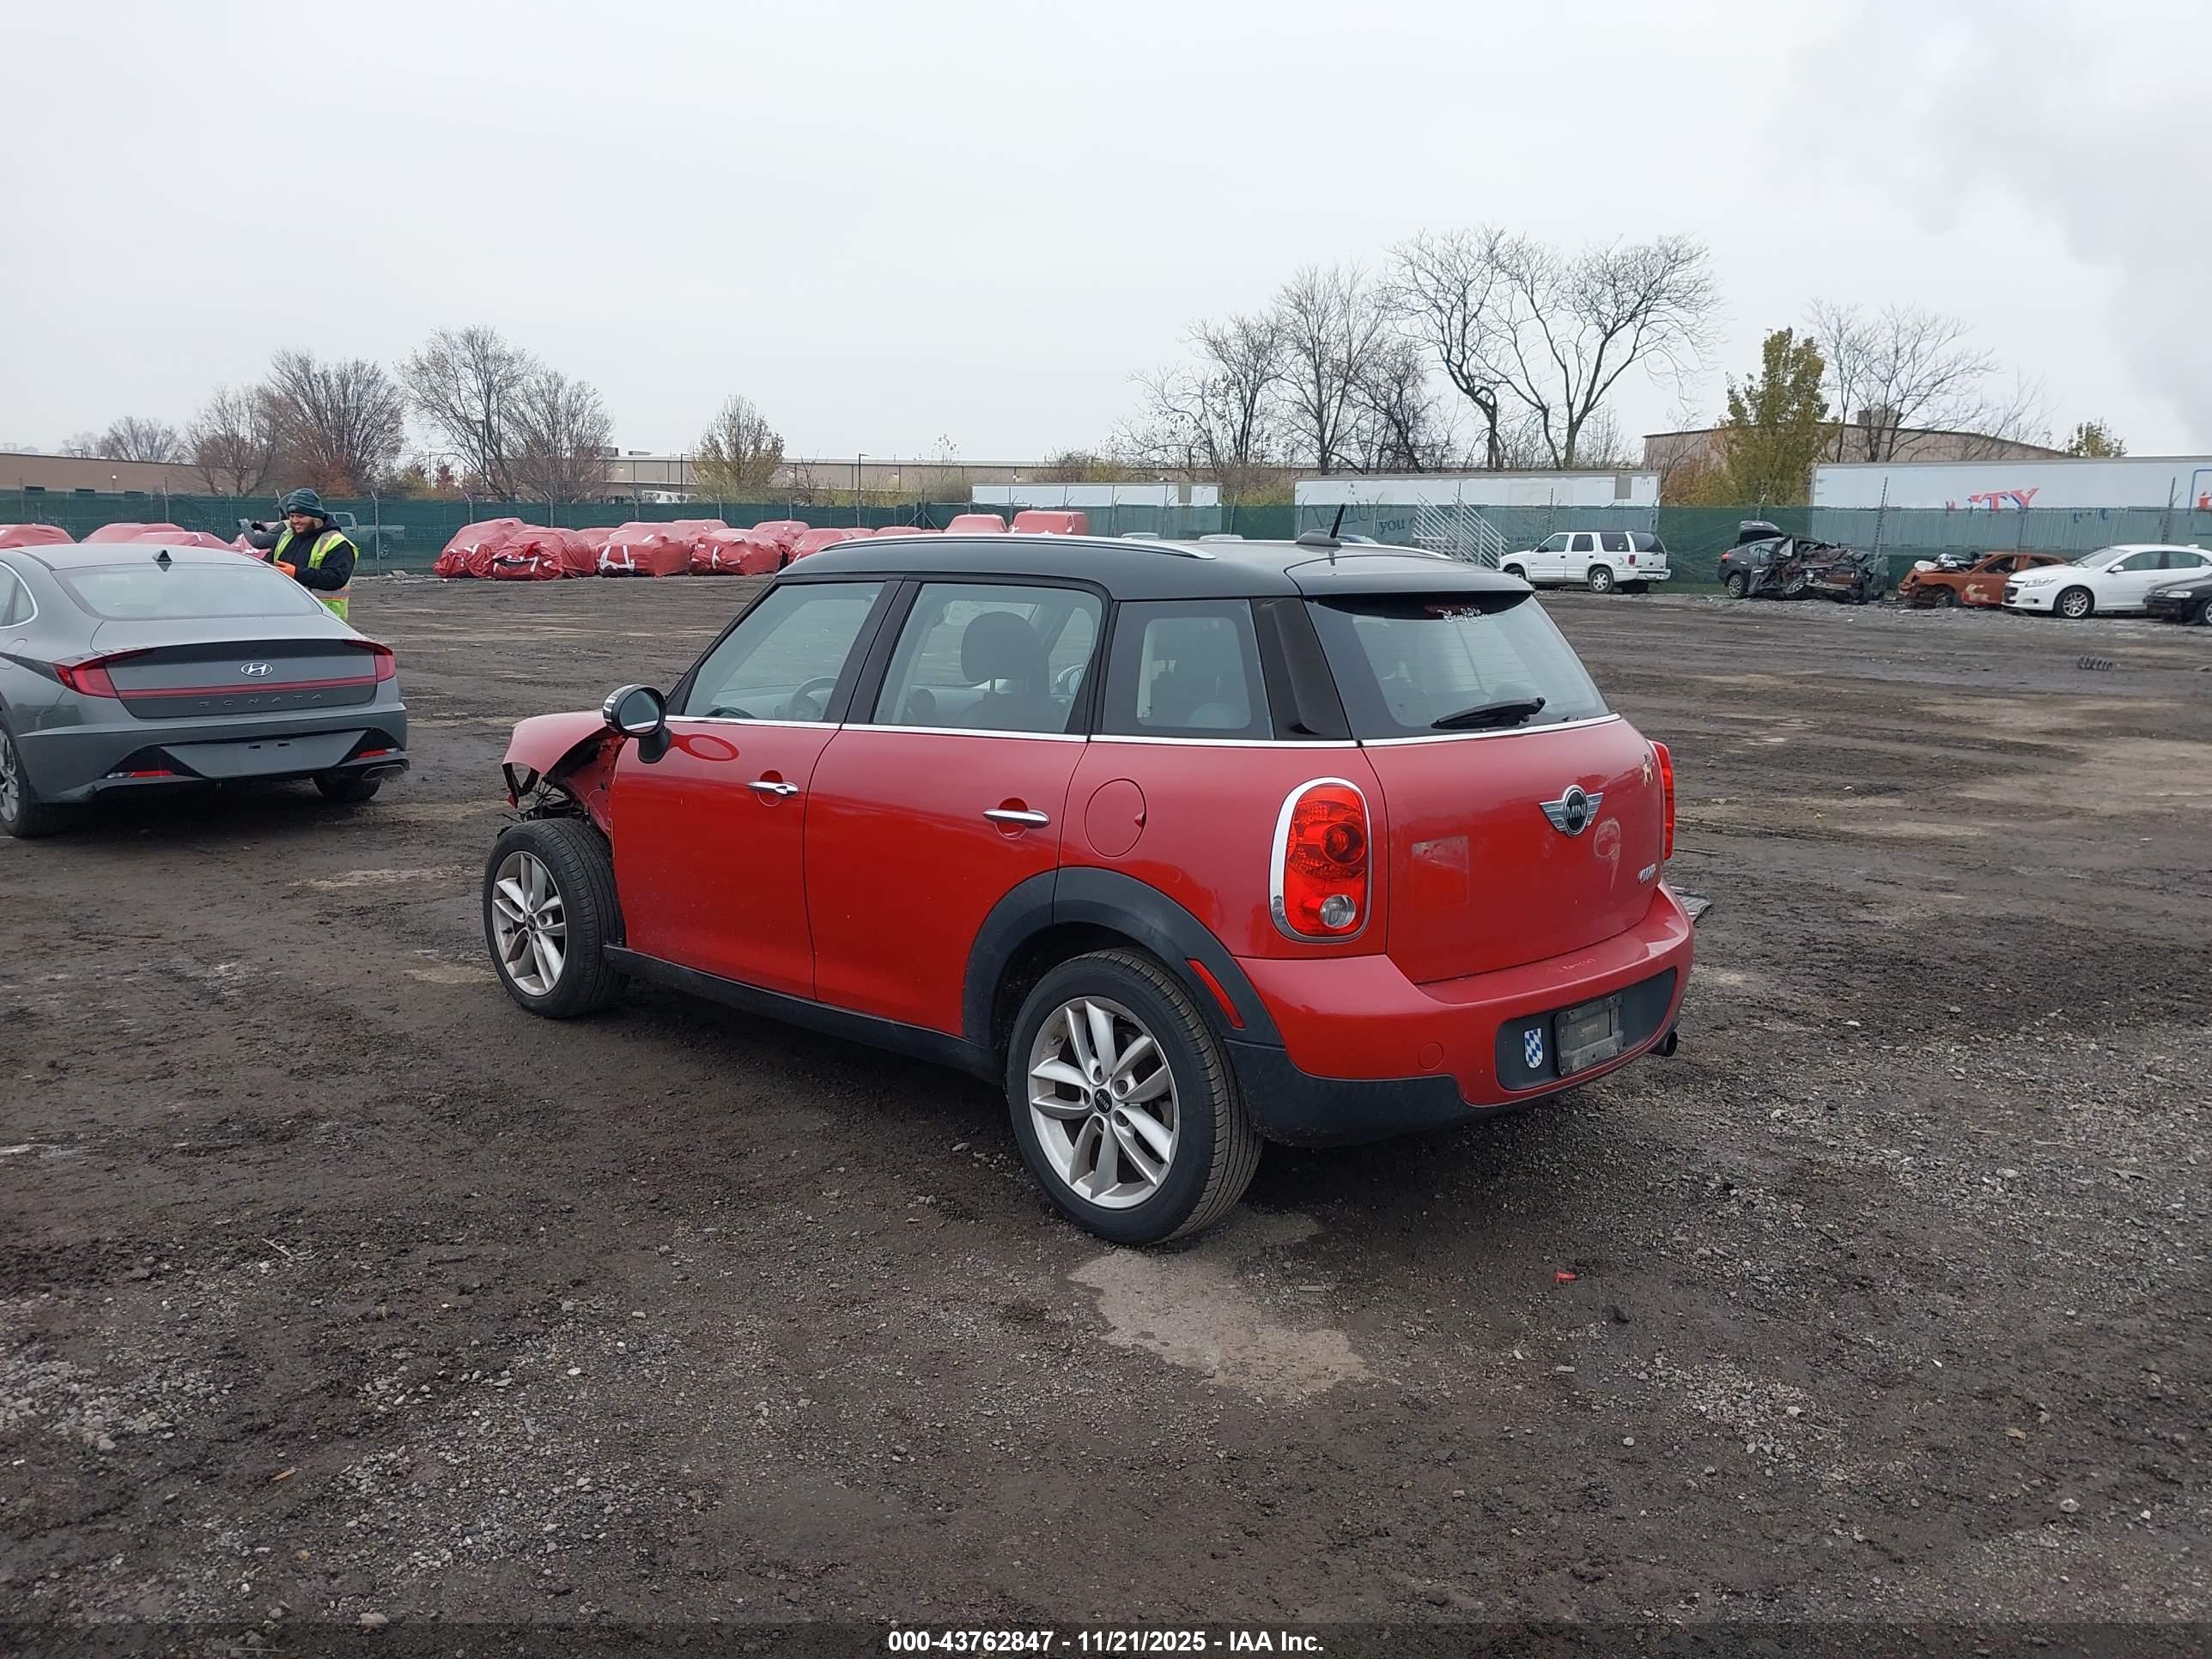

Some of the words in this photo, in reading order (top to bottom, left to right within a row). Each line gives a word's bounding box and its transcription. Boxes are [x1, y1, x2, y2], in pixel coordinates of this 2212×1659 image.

[1378, 518, 1407, 536] you
[198, 693, 323, 708] SONATA
[1566, 803, 1586, 819] MINI
[1096, 1092, 1110, 1110] MINI
